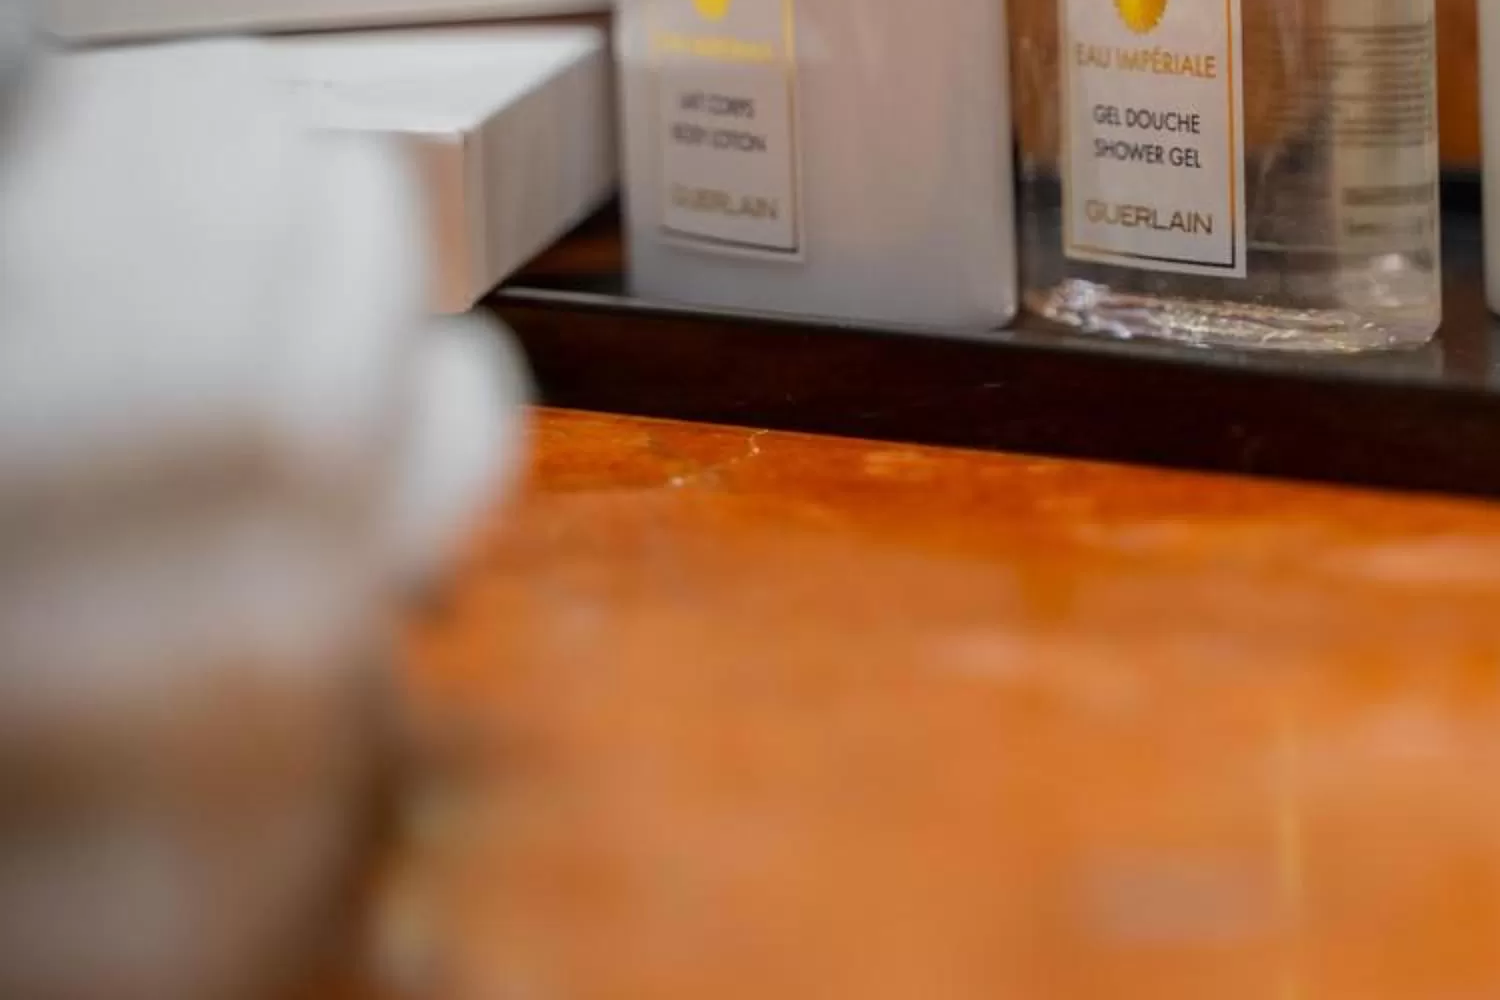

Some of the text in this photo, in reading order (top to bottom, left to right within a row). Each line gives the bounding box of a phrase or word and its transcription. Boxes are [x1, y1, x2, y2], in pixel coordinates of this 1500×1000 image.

[1076, 43, 1216, 78] EAU IMPÉRIALE
[1093, 104, 1200, 134] GEL DOUCHE
[1093, 137, 1202, 168] SHOWER GEL
[1085, 199, 1214, 235] GUERLAIN
